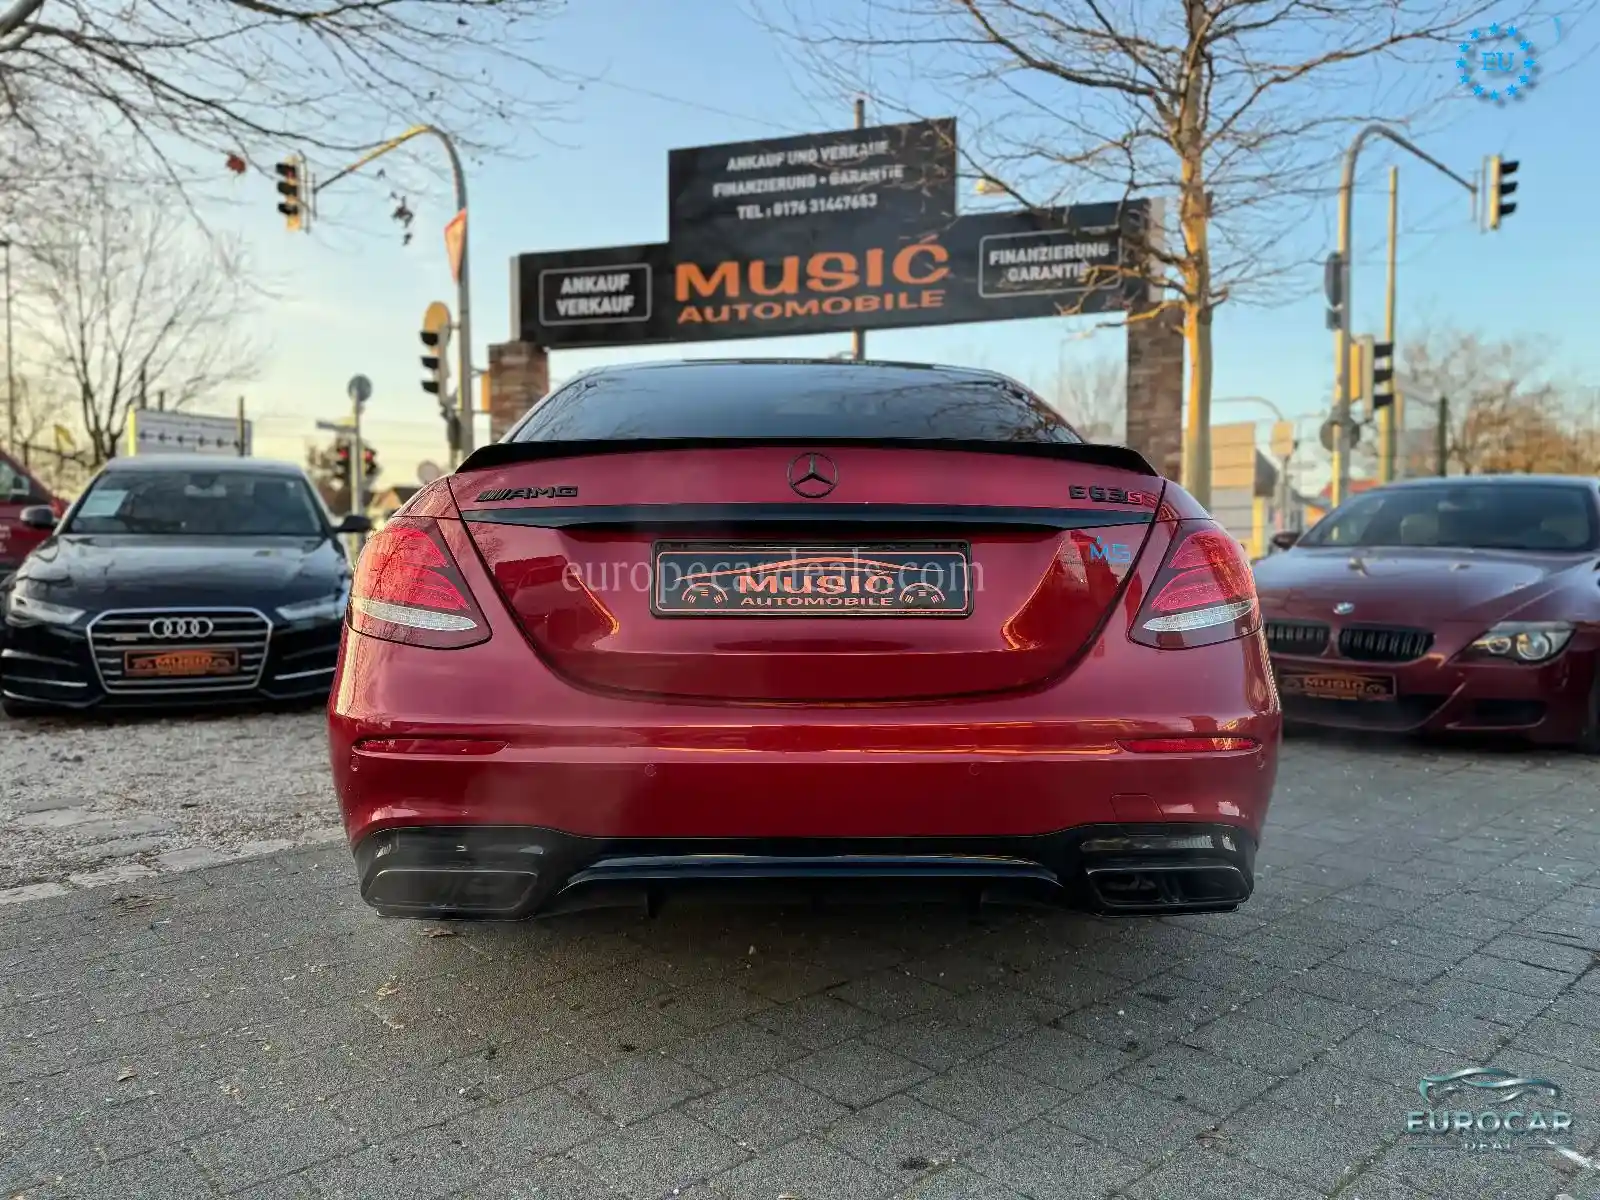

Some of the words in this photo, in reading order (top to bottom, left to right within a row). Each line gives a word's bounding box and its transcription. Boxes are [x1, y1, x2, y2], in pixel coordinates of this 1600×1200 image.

[726, 151, 785, 171] ANKAUF
[787, 149, 818, 164] UND
[819, 140, 890, 162] VERKAUF
[713, 174, 817, 198] FINANZIERUNG
[829, 164, 904, 185] GARANTIE
[737, 204, 764, 220] TEL
[773, 199, 808, 216] 0176
[989, 242, 1110, 265] FINANZIERUNG
[560, 274, 630, 294] ANKAUF
[556, 295, 635, 317] VERKAUF
[677, 289, 947, 324] AUTOMOBILE
[740, 597, 894, 606] AUTOMOBILE
